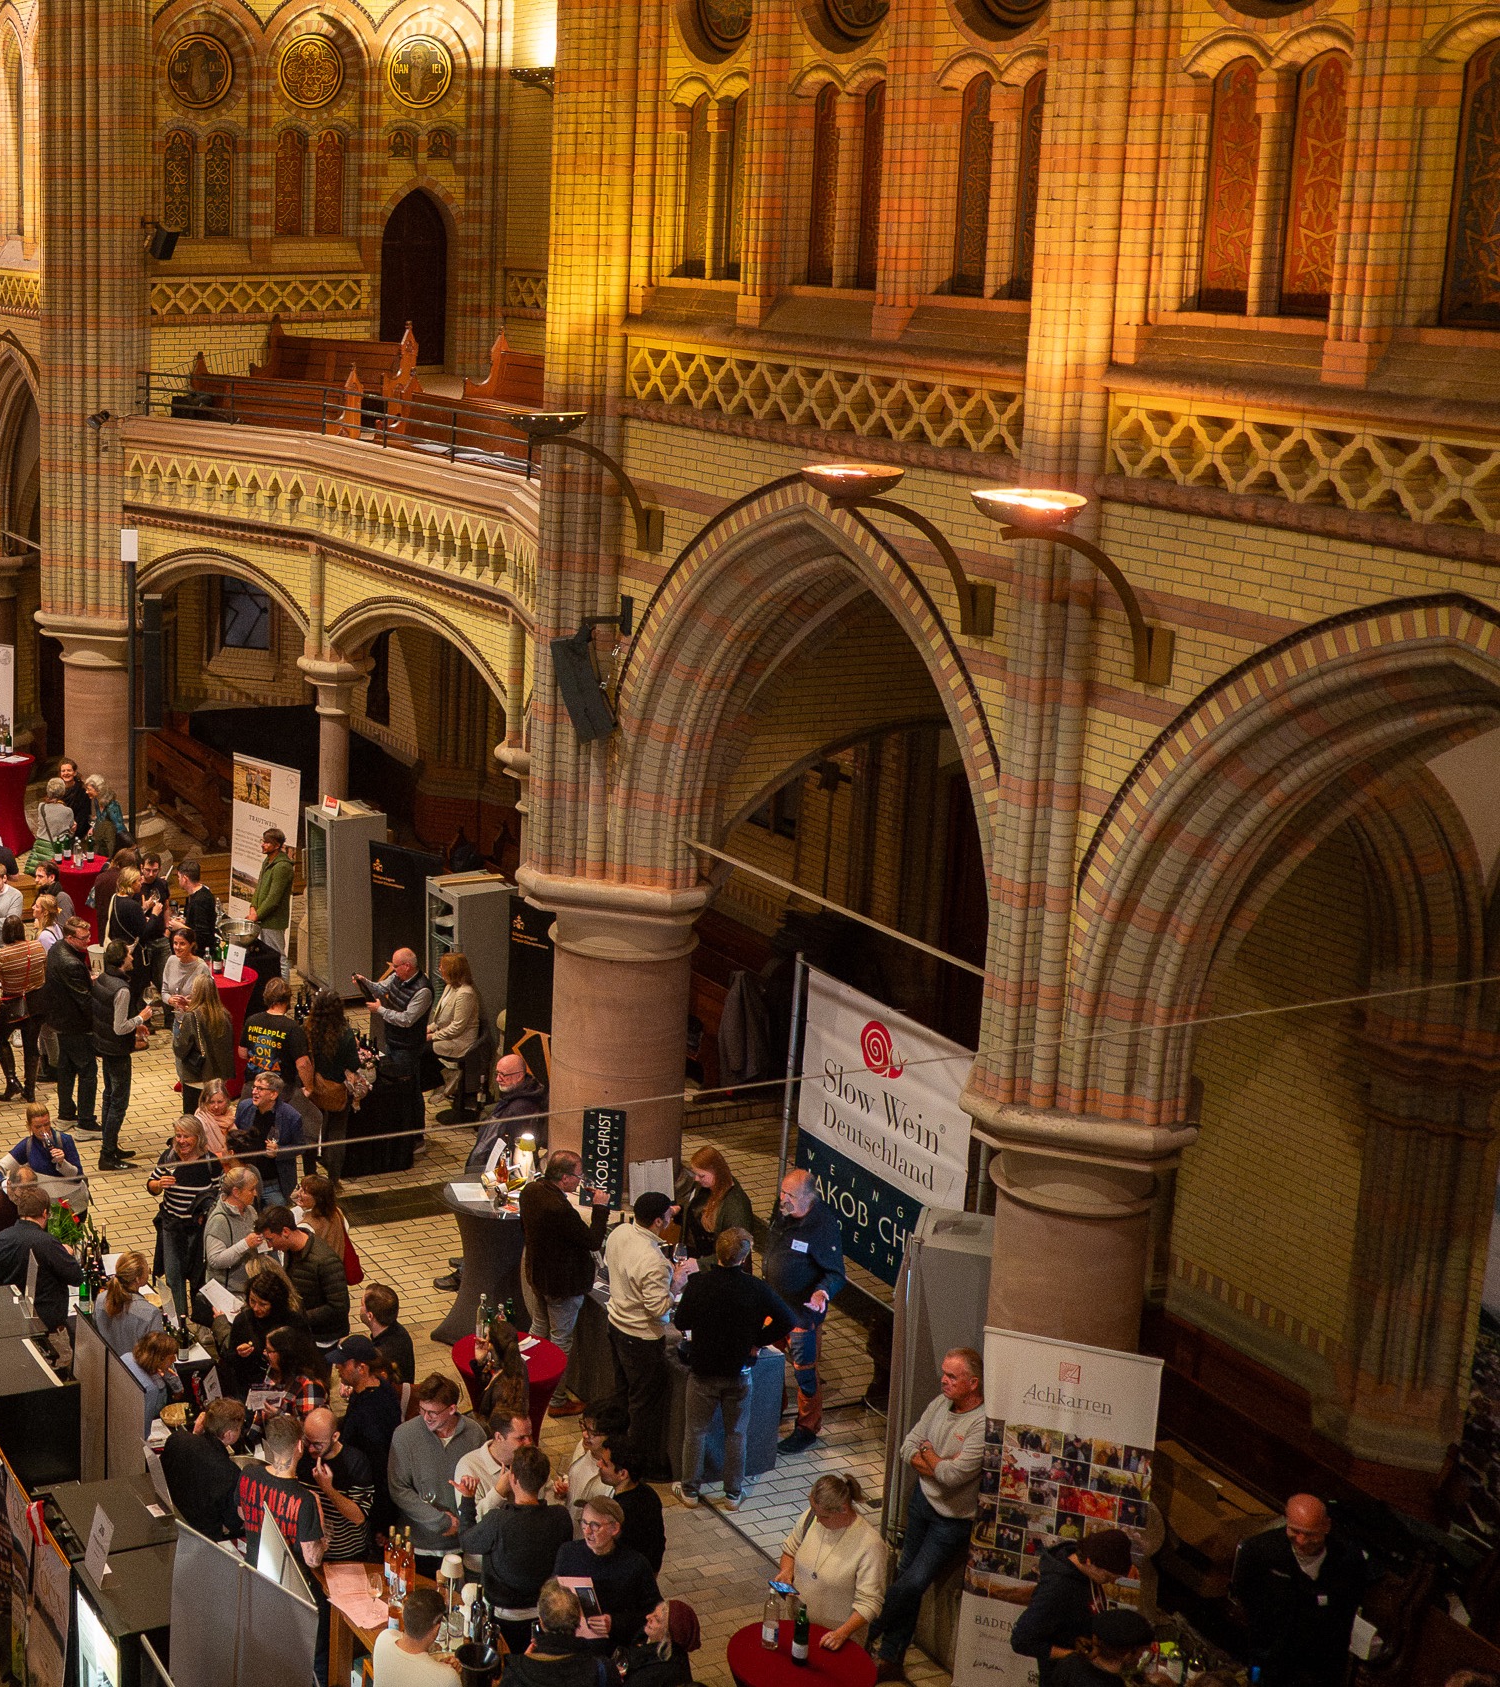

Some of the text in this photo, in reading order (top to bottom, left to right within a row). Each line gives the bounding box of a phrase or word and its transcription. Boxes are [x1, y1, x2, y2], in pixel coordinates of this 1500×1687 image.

[394, 63, 443, 74] DAN IEL
[247, 1025, 287, 1040] PINEAPPLE
[248, 1034, 282, 1050] BELONGS
[255, 1046, 271, 1058] ON
[823, 1058, 940, 1157] Slow Wein
[595, 1113, 612, 1192] KOB CHRIST
[823, 1101, 935, 1192] Deutschland
[807, 1148, 904, 1219] WEING
[808, 1169, 868, 1228] AKOB
[1023, 1383, 1113, 1416] Achkarren
